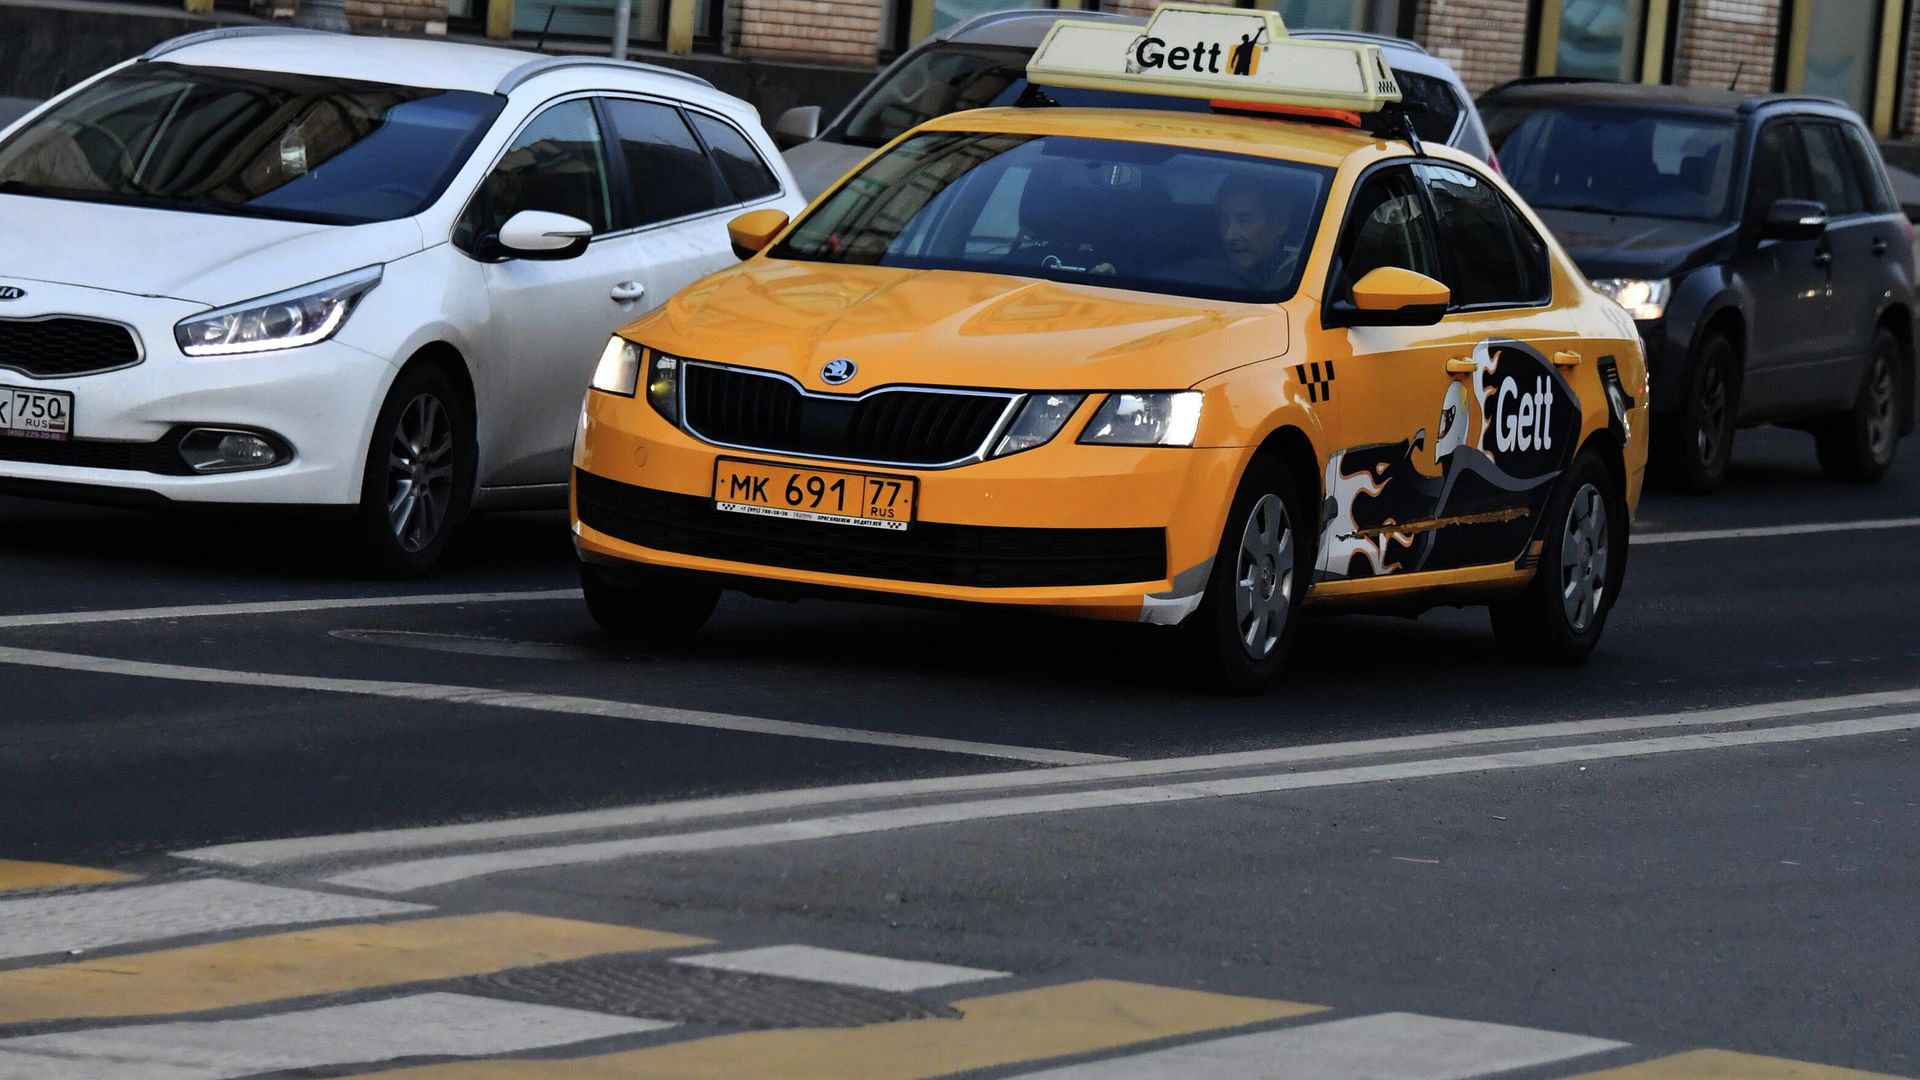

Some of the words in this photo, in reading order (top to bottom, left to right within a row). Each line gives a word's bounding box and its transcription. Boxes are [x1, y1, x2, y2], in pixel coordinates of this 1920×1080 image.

[1136, 37, 1221, 74] Gett
[17, 394, 61, 420] 750
[1495, 375, 1554, 453] Gett
[25, 418, 48, 429] RUS
[730, 474, 770, 503] MK
[785, 474, 845, 511] 691
[869, 479, 902, 507] 77
[870, 507, 895, 518] RUS
